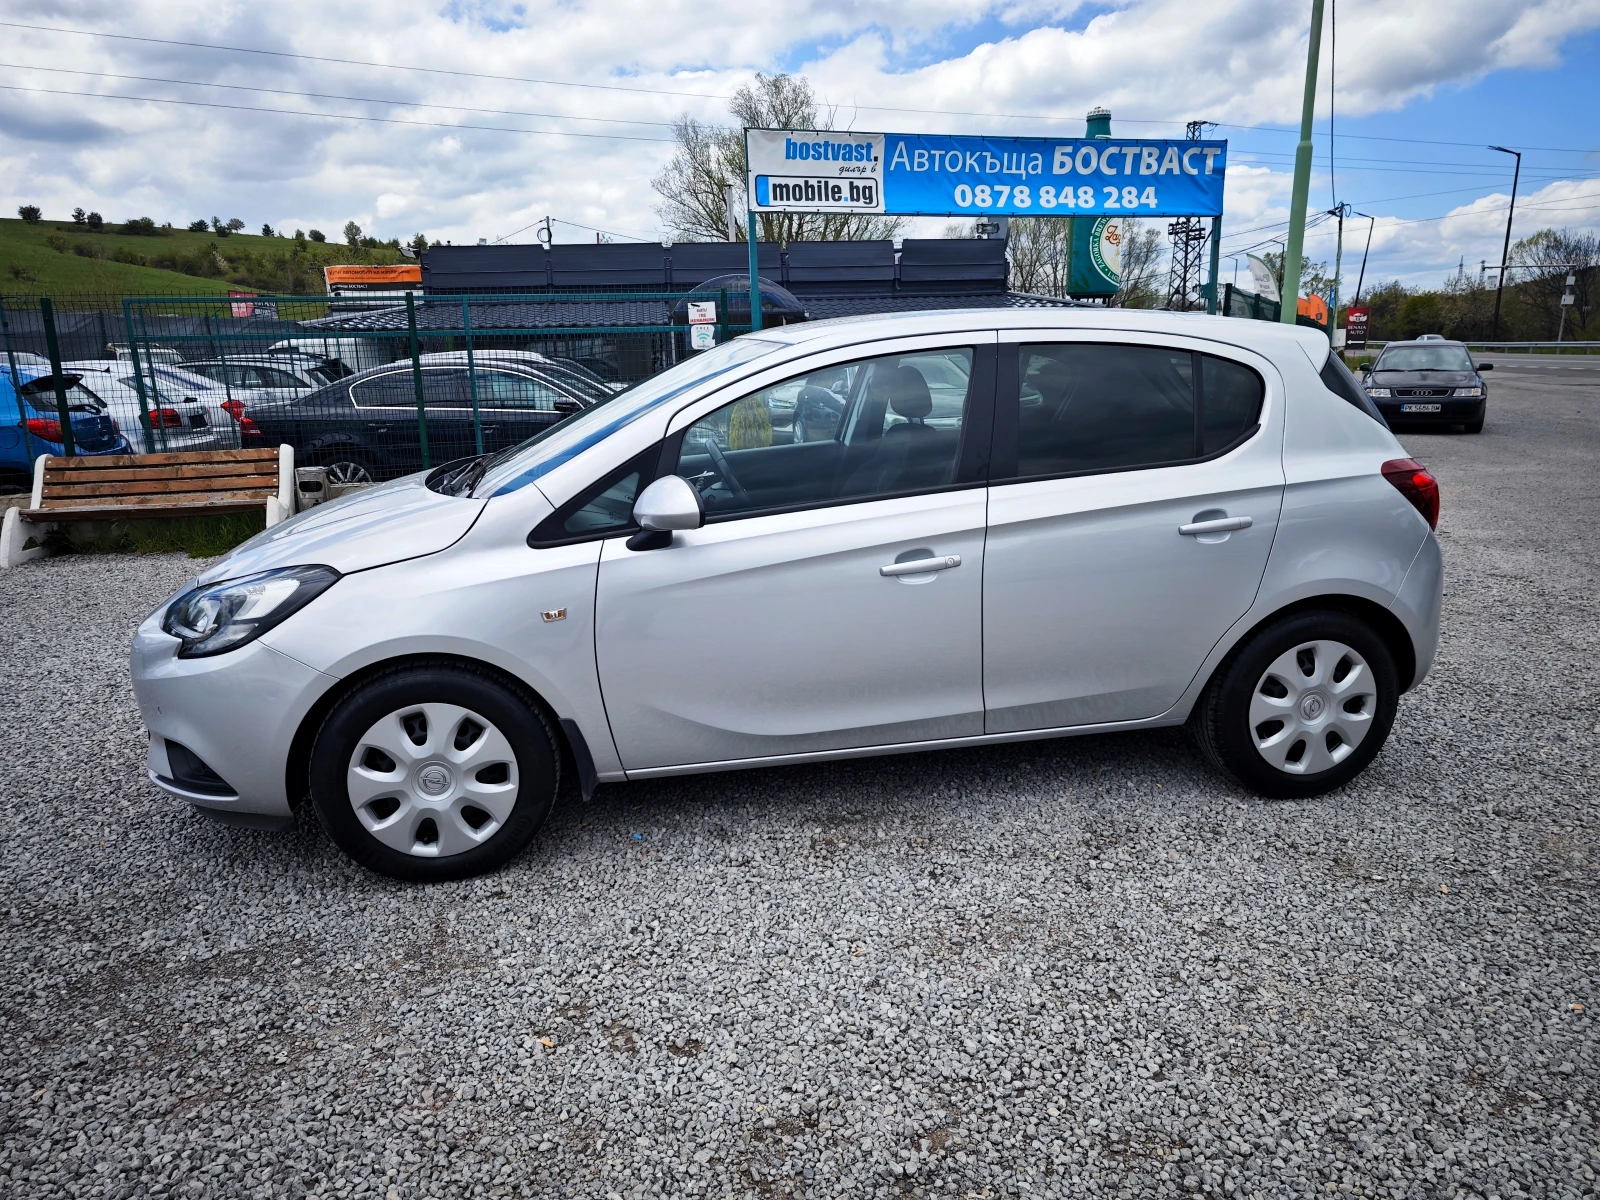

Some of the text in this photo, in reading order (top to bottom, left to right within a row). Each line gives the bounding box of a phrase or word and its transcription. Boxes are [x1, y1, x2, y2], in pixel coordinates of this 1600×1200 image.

[838, 165, 867, 175] дилър
[1052, 145, 1221, 175] БОСТВАСТ
[772, 180, 873, 204] mobile.bg
[954, 184, 1158, 209] 0878 848 284
